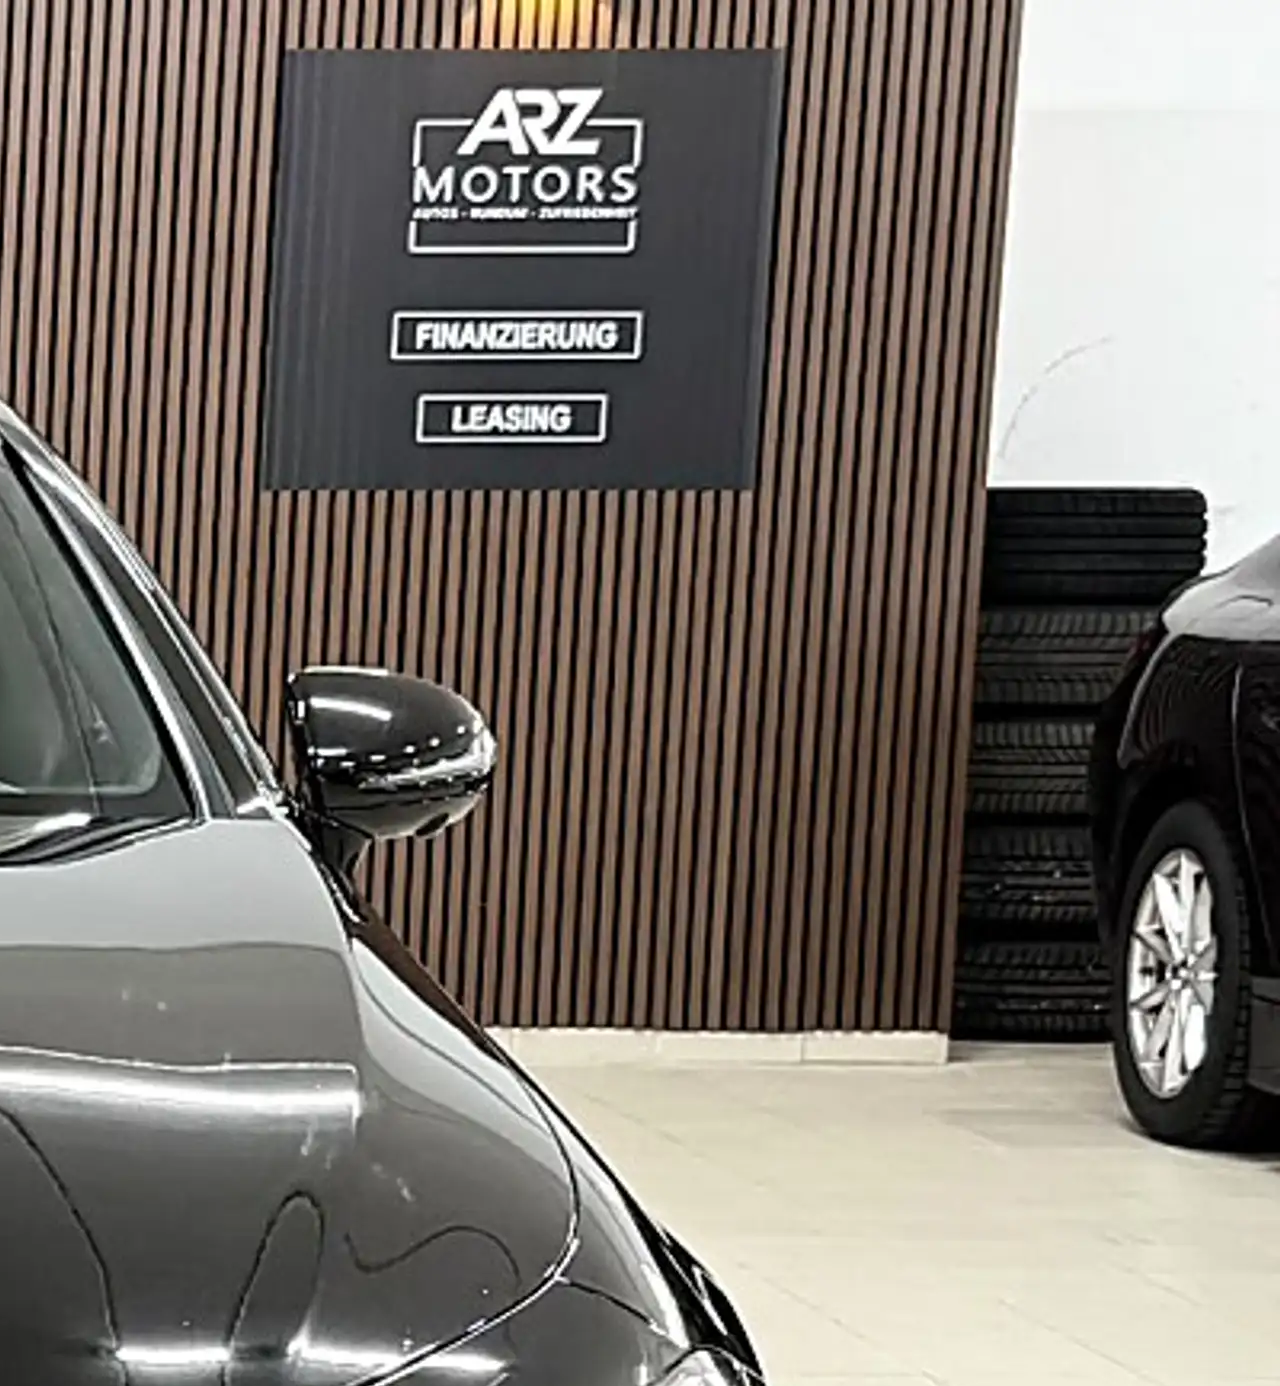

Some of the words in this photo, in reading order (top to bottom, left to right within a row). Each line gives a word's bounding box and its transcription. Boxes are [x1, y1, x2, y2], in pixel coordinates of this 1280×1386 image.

[456, 88, 604, 155] ARZ
[412, 165, 638, 204] MOTORS
[415, 322, 618, 351] FINANZIERUNG
[451, 404, 572, 434] LEASING
